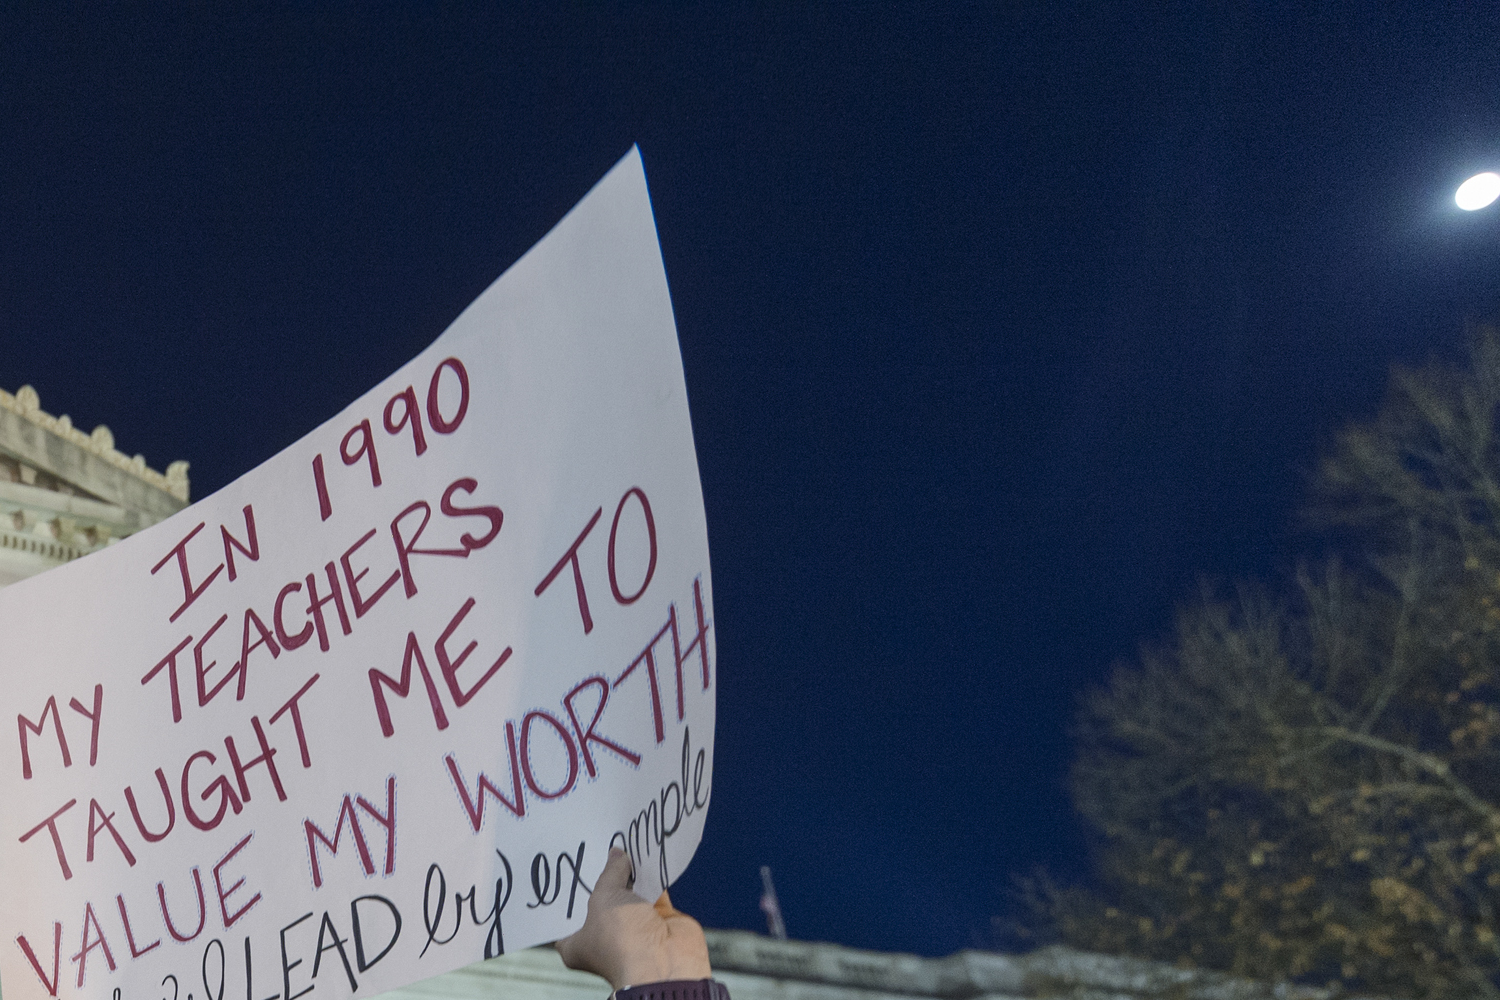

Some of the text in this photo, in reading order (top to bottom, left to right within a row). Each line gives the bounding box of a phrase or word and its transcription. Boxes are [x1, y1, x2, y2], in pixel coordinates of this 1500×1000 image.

[17, 477, 504, 780] MY TEACHERS
[151, 357, 470, 623] IN 1990
[15, 573, 712, 998] VALUE MY WORTH
[18, 486, 657, 881] TAUGHT ME TO
[419, 847, 513, 962] by
